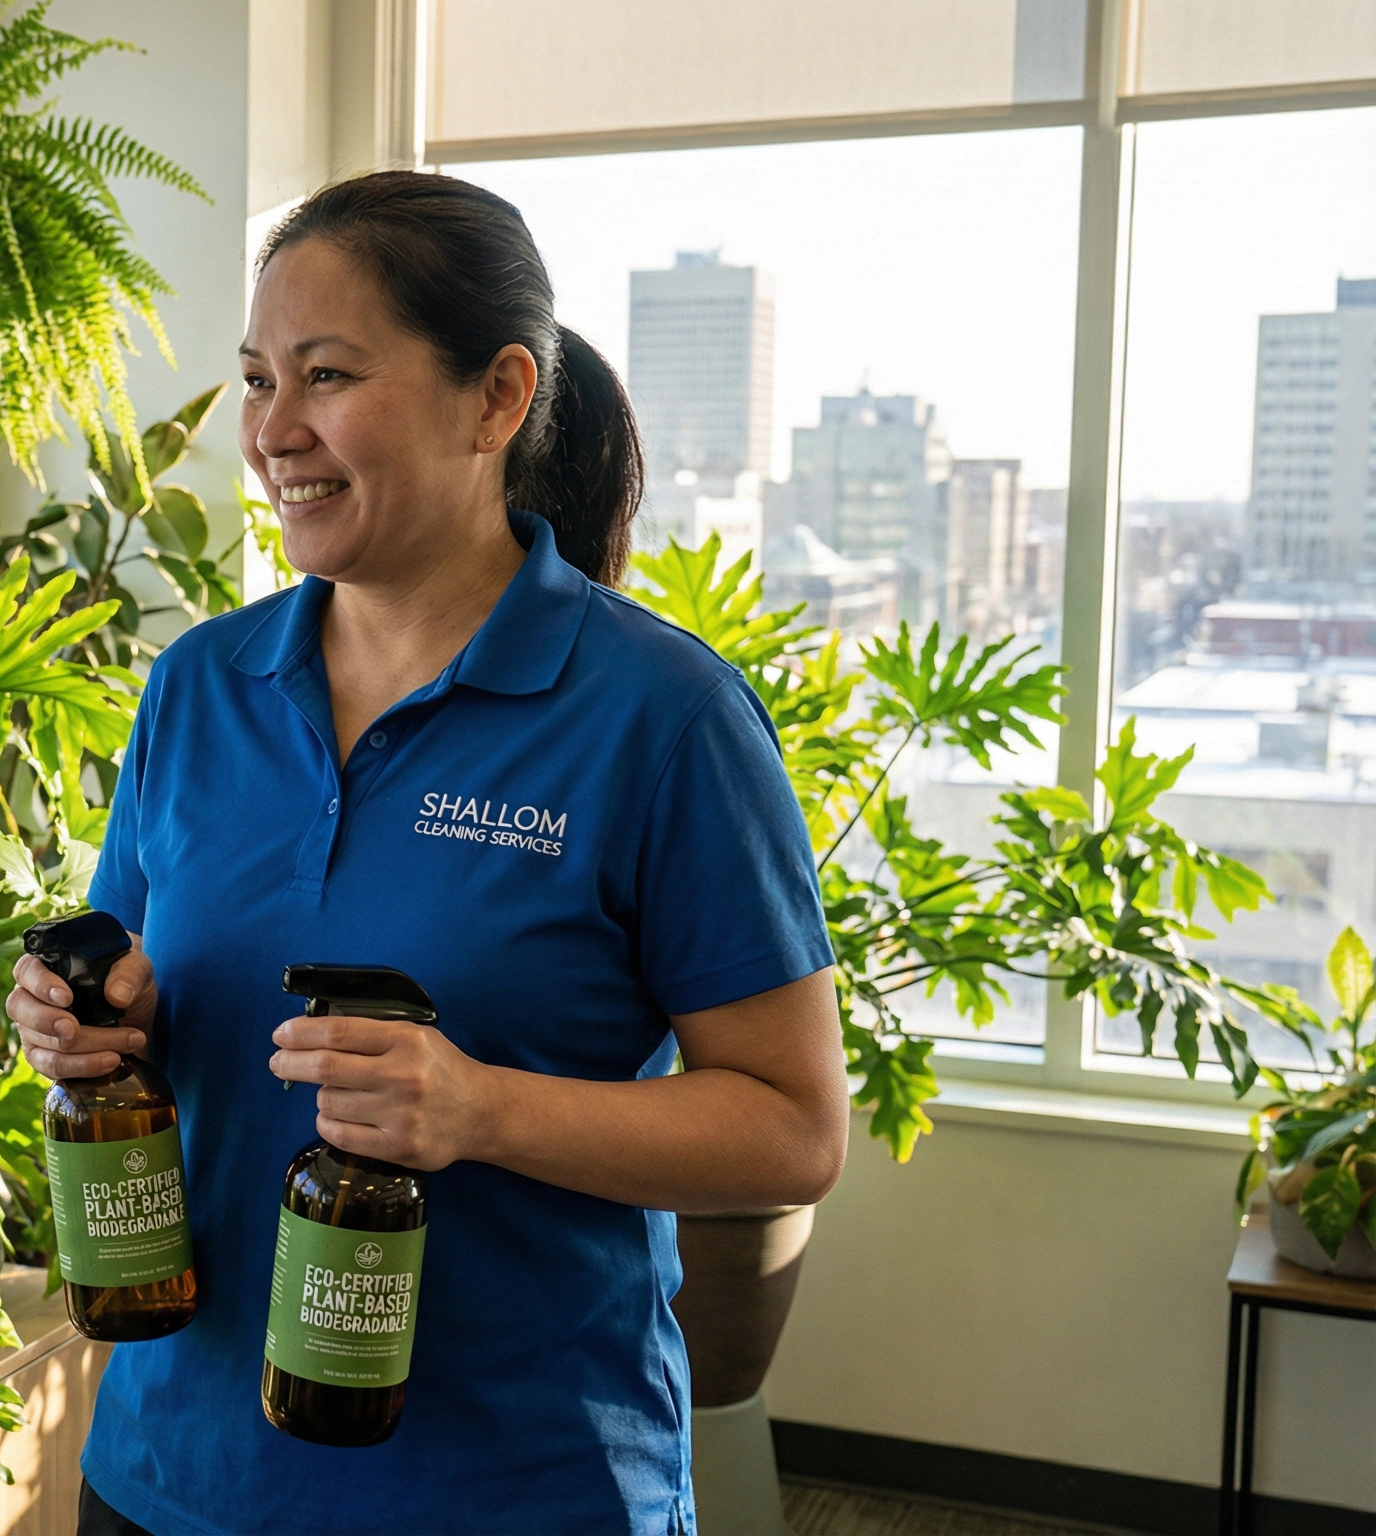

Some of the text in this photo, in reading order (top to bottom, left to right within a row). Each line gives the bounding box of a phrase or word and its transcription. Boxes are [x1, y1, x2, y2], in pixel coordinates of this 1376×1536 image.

[419, 792, 568, 838] SHALLOM
[414, 820, 563, 856] CLEANING SERVICES
[82, 1166, 181, 1201] ECO-CERTIFIED
[84, 1185, 183, 1220] PLANT-BASED
[304, 1263, 414, 1294] ECO-CERTIFIED
[302, 1283, 412, 1315] PLANT-BASED
